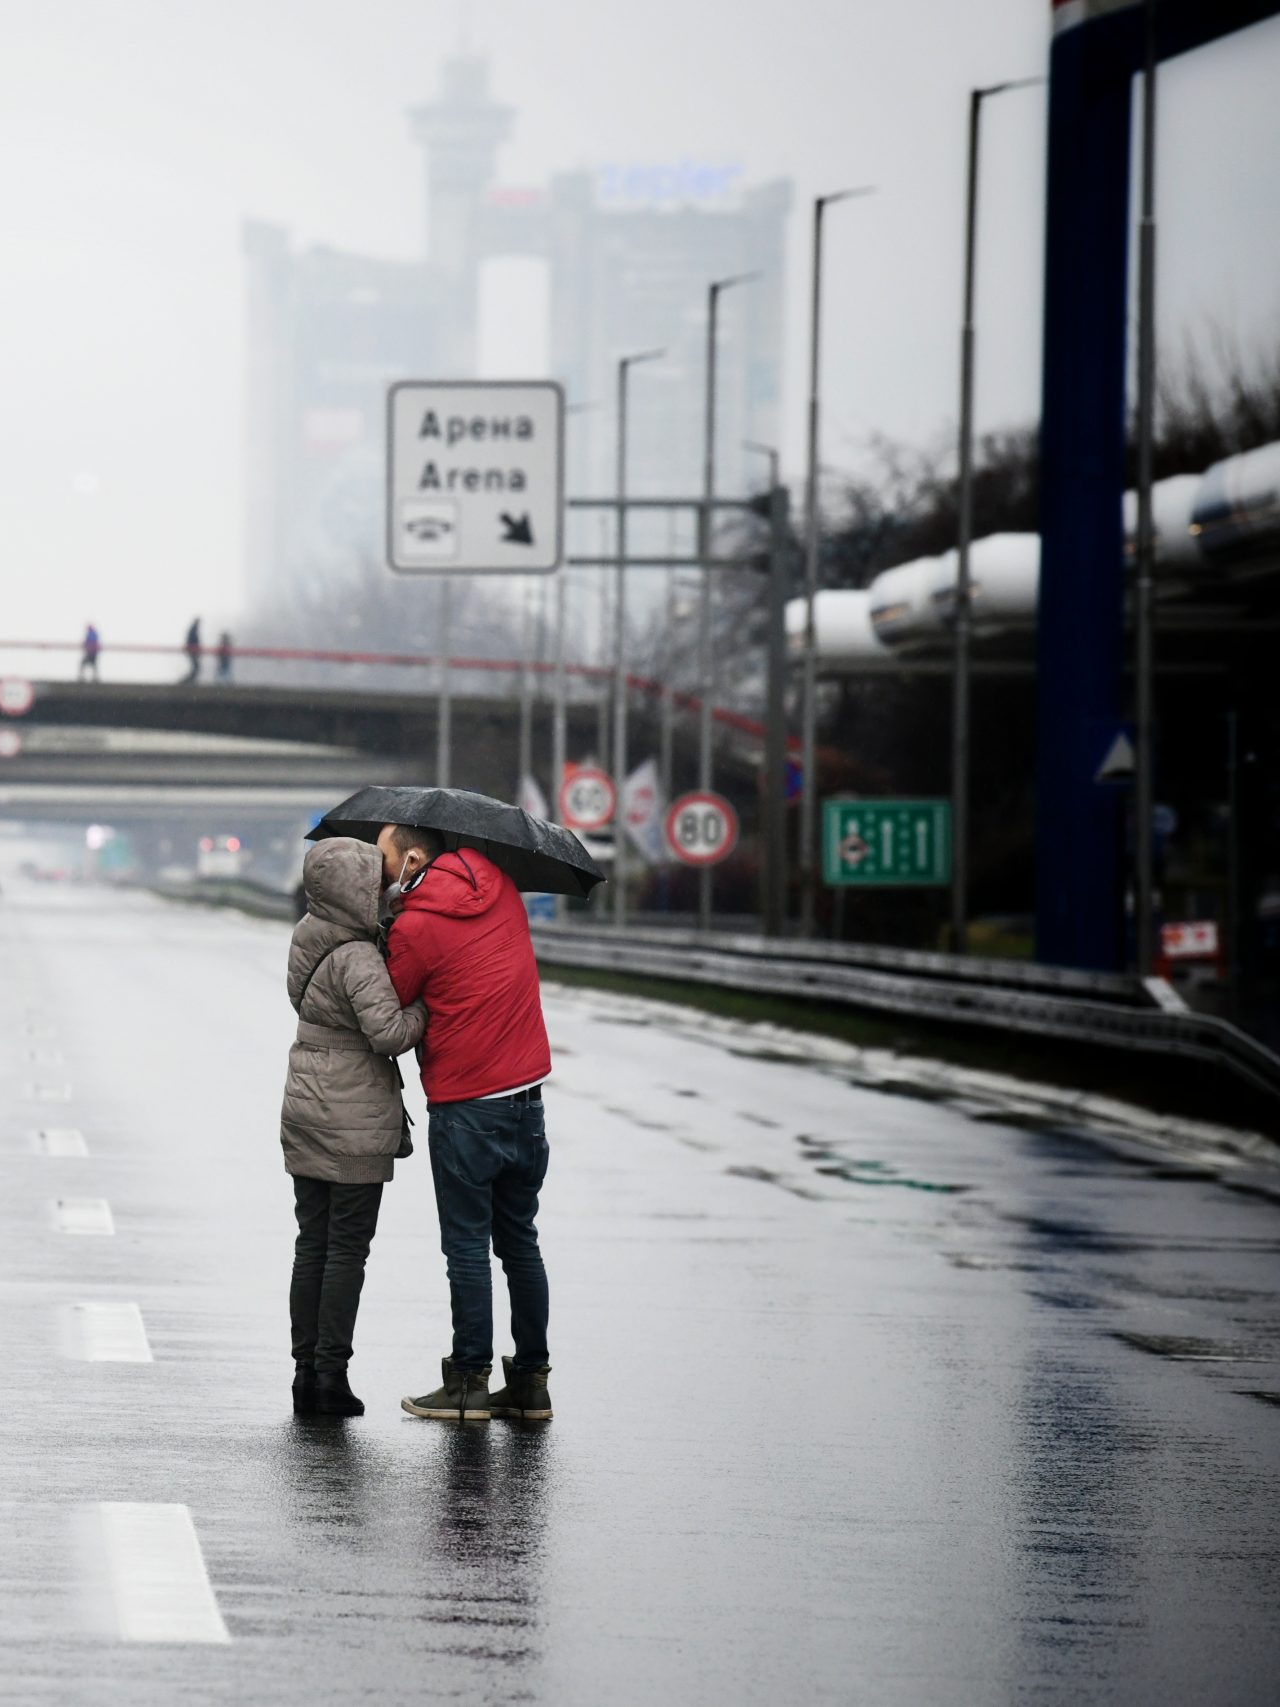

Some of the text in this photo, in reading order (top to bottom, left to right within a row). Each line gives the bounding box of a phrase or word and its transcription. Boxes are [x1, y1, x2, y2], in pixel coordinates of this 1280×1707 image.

[419, 409, 534, 446] Арена
[419, 460, 527, 491] Arena
[680, 811, 722, 846] 80
